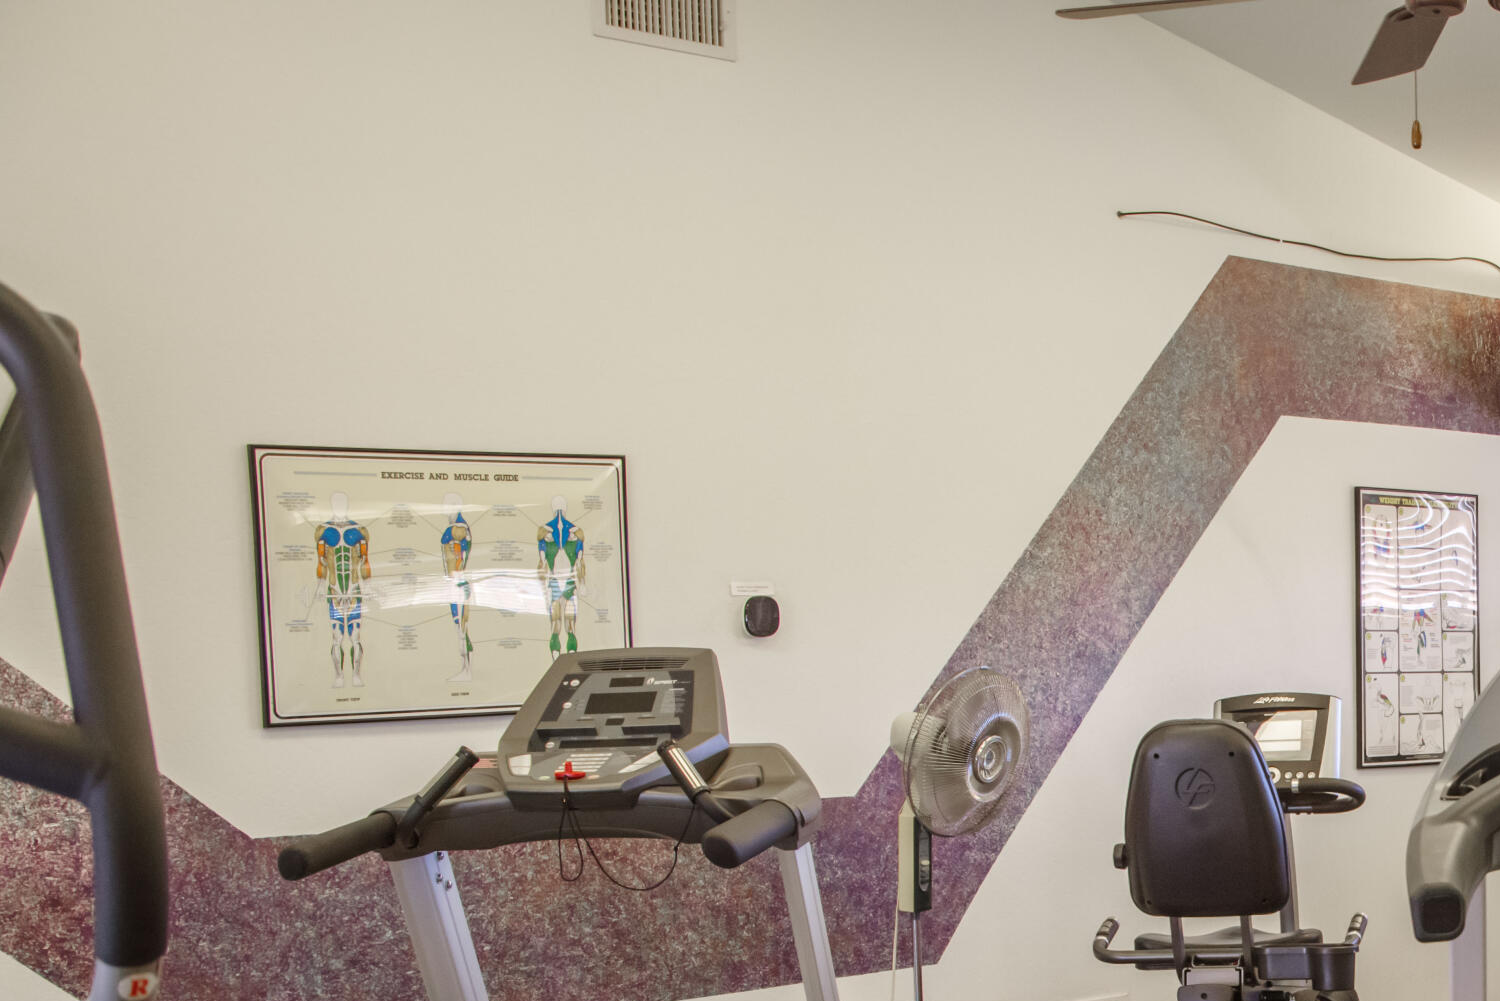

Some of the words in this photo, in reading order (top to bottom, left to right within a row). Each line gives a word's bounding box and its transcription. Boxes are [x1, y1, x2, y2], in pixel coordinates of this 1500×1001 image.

[381, 471, 424, 480] EXERCISE
[429, 472, 448, 480] AND
[454, 473, 489, 481] MUSCLE
[494, 474, 519, 482] GUIDE
